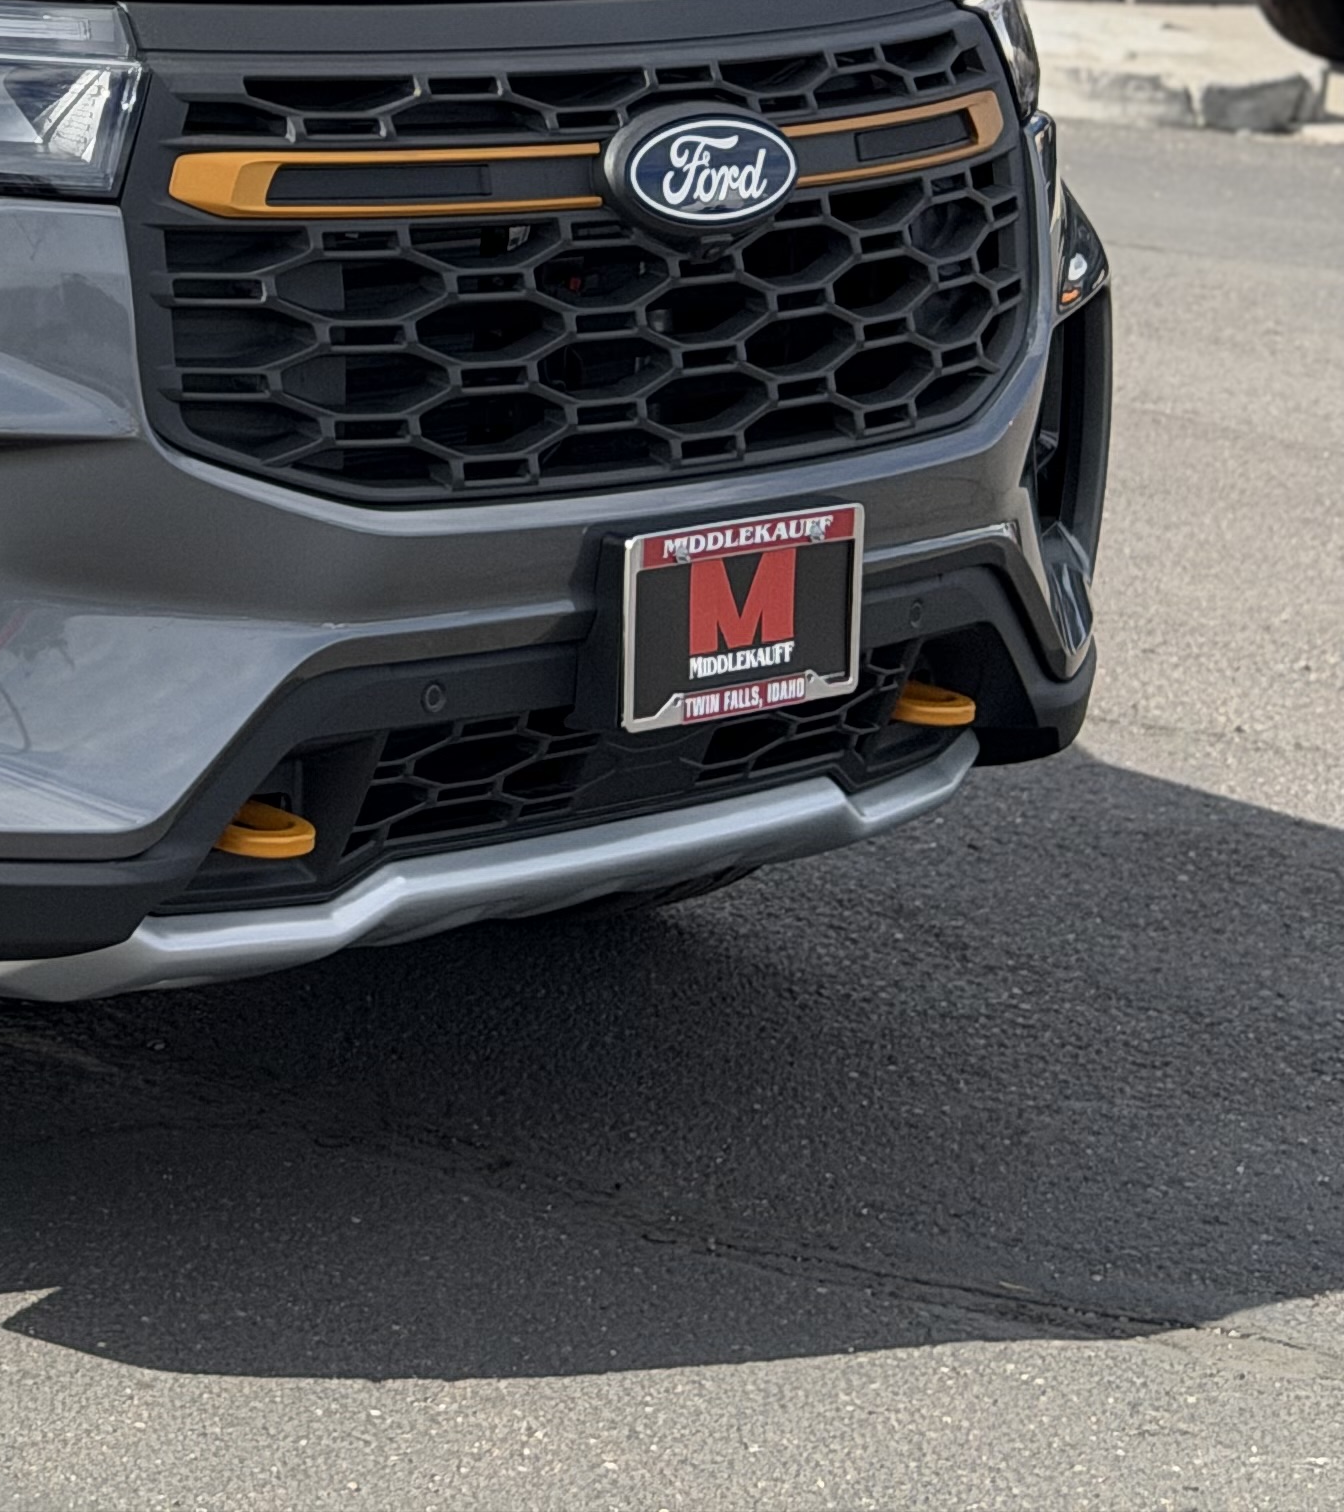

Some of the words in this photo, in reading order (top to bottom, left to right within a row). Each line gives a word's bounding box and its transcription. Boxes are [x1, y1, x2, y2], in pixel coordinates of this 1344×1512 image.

[662, 135, 768, 205] Ford
[663, 515, 834, 559] MIDDLEKAUFF
[688, 548, 796, 656] M
[688, 640, 795, 681] MIDDLEKAUFF
[684, 693, 720, 718] TWIN
[723, 683, 764, 710] FALLS,
[767, 676, 806, 702] IDAHO
